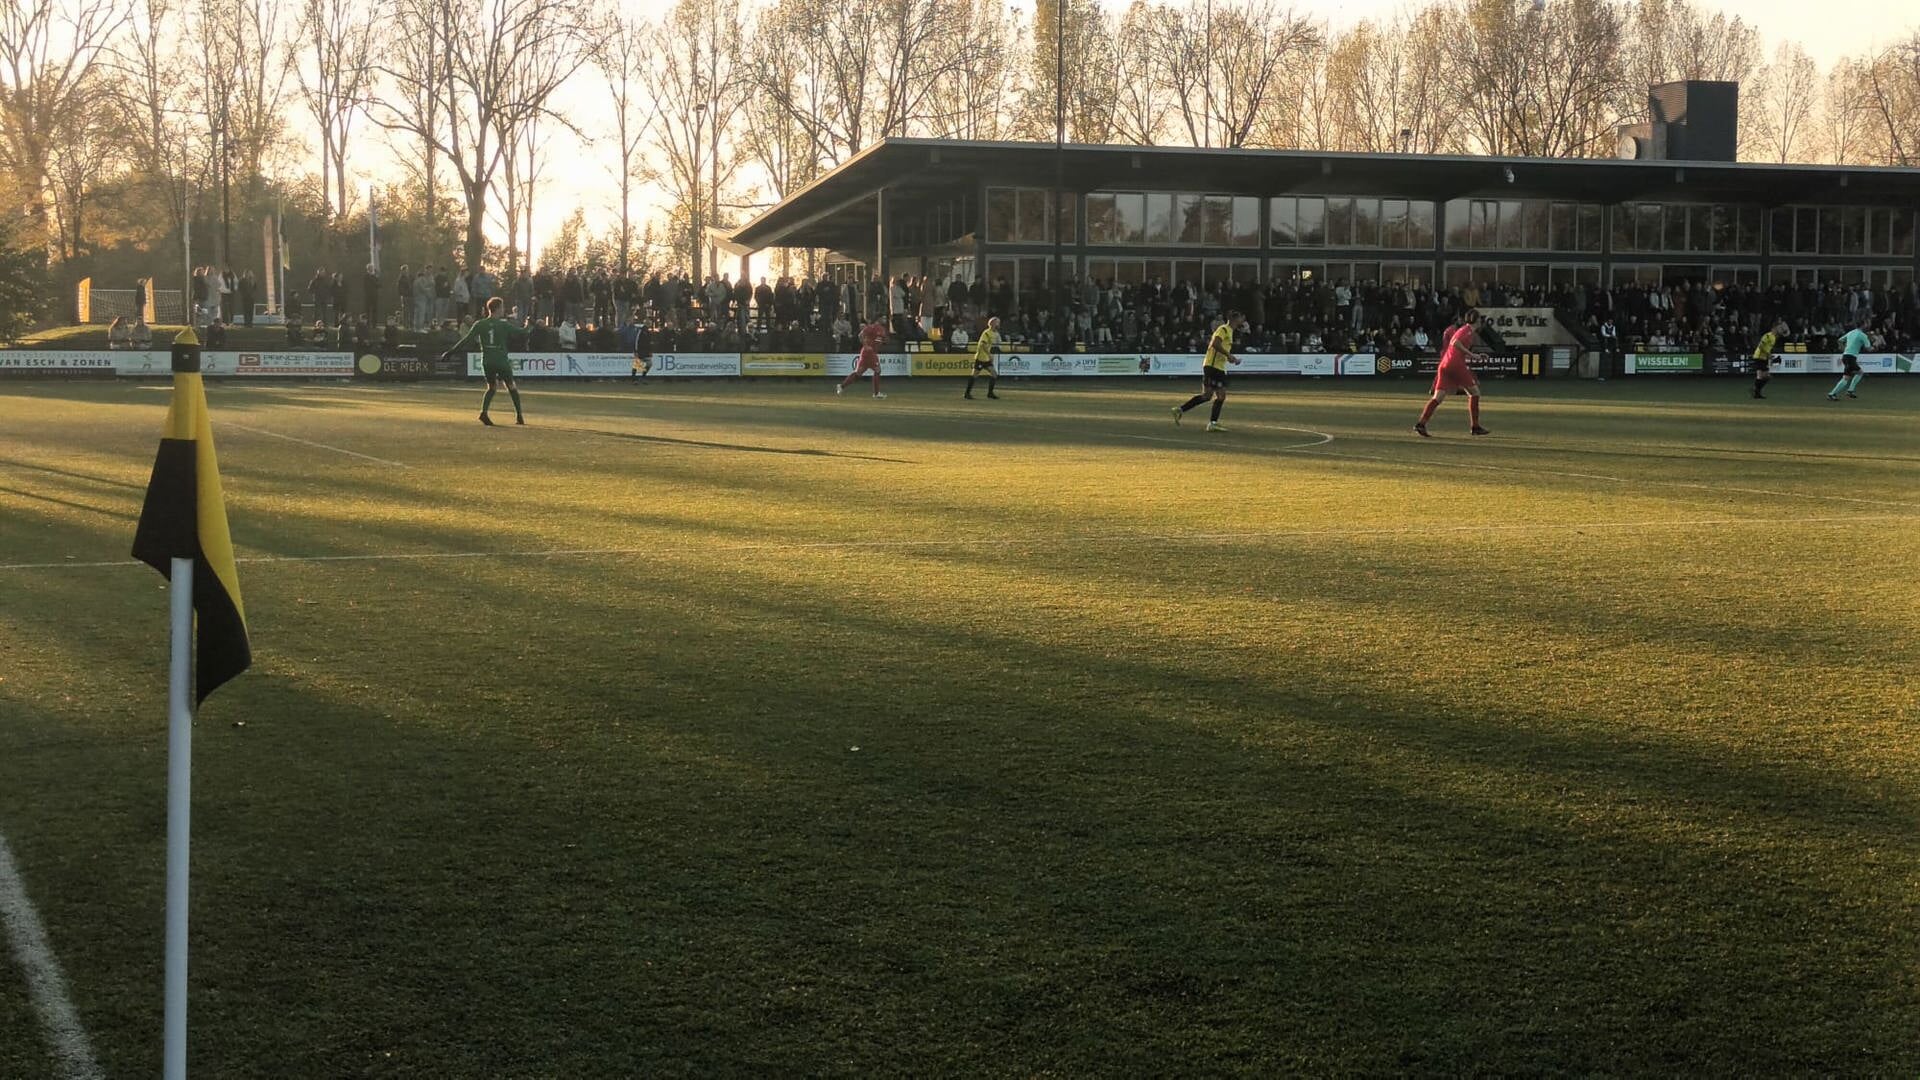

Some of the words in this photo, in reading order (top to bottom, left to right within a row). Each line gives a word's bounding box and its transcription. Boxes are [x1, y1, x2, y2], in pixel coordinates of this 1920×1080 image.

[1497, 315, 1513, 327] de
[1516, 315, 1548, 327] Valk
[488, 328, 494, 344] 1
[656, 355, 676, 371] JB
[1391, 359, 1412, 367] SAVO
[1638, 356, 1689, 366] WISSELEN!
